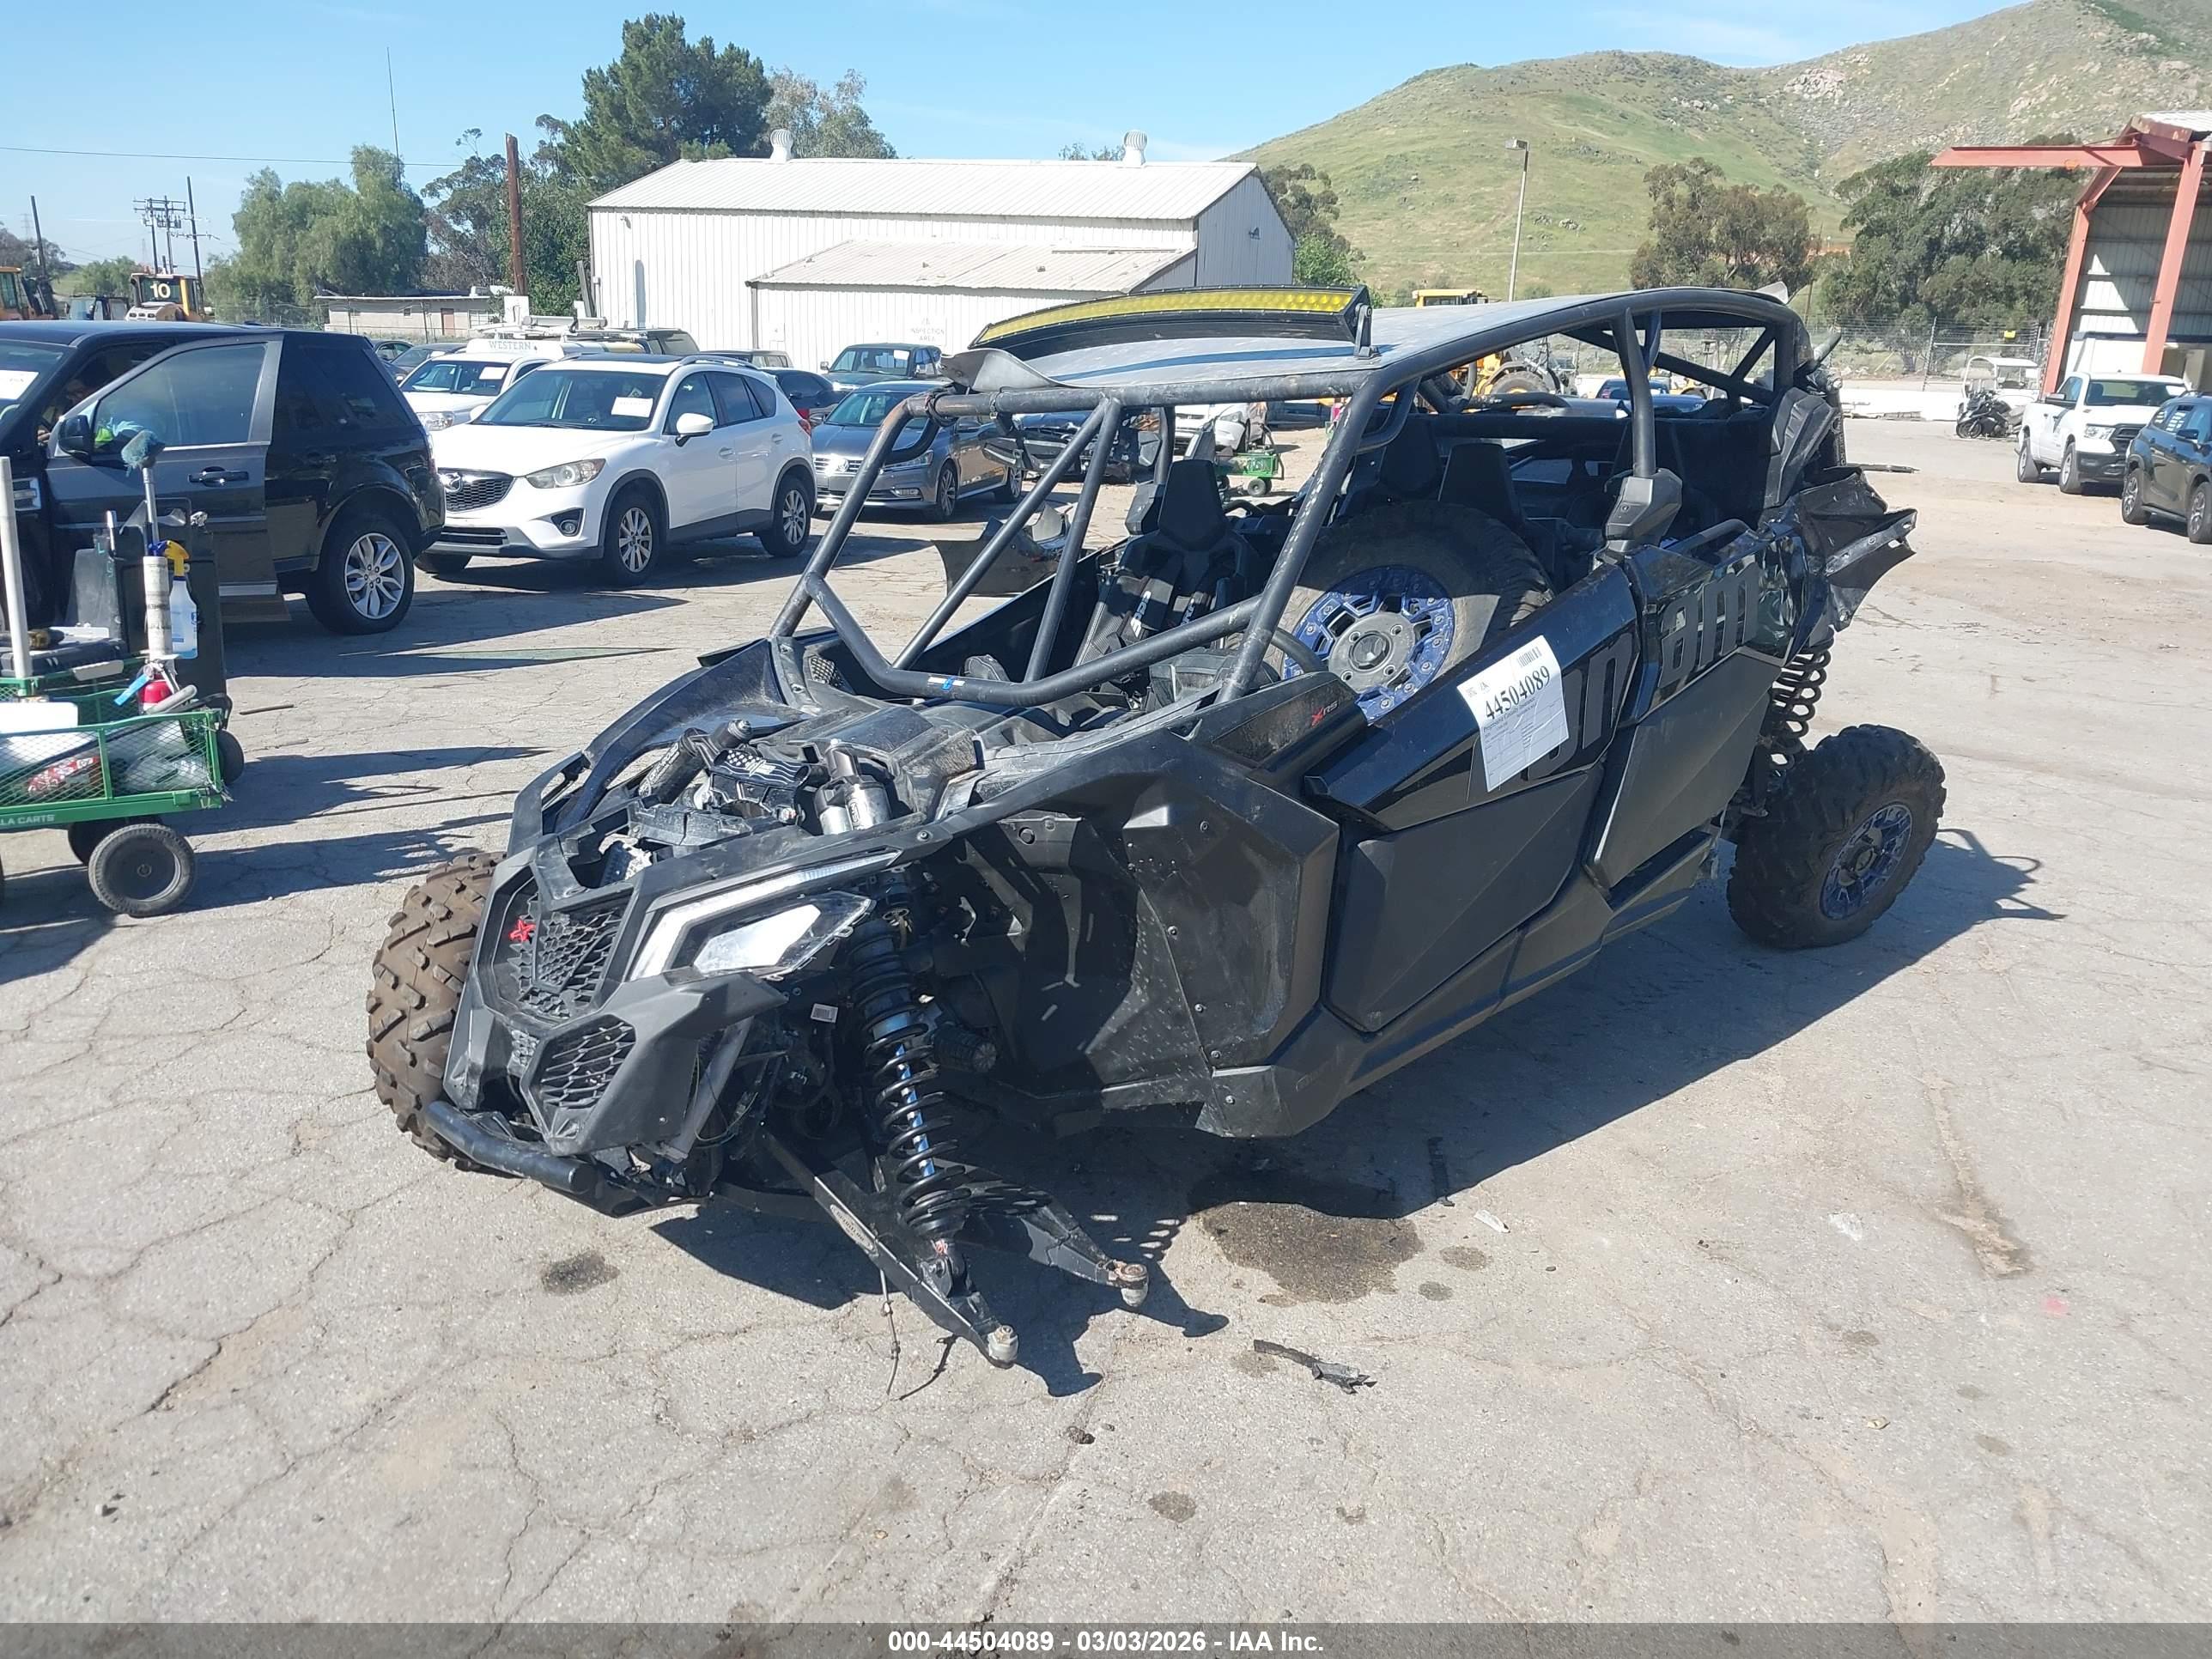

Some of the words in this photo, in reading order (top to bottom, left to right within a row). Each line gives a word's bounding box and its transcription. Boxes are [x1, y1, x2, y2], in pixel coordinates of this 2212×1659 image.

[149, 282, 171, 299] 10
[488, 340, 532, 350] WESTERN
[1486, 665, 1550, 720] 44504089
[17, 814, 55, 824] CARTS
